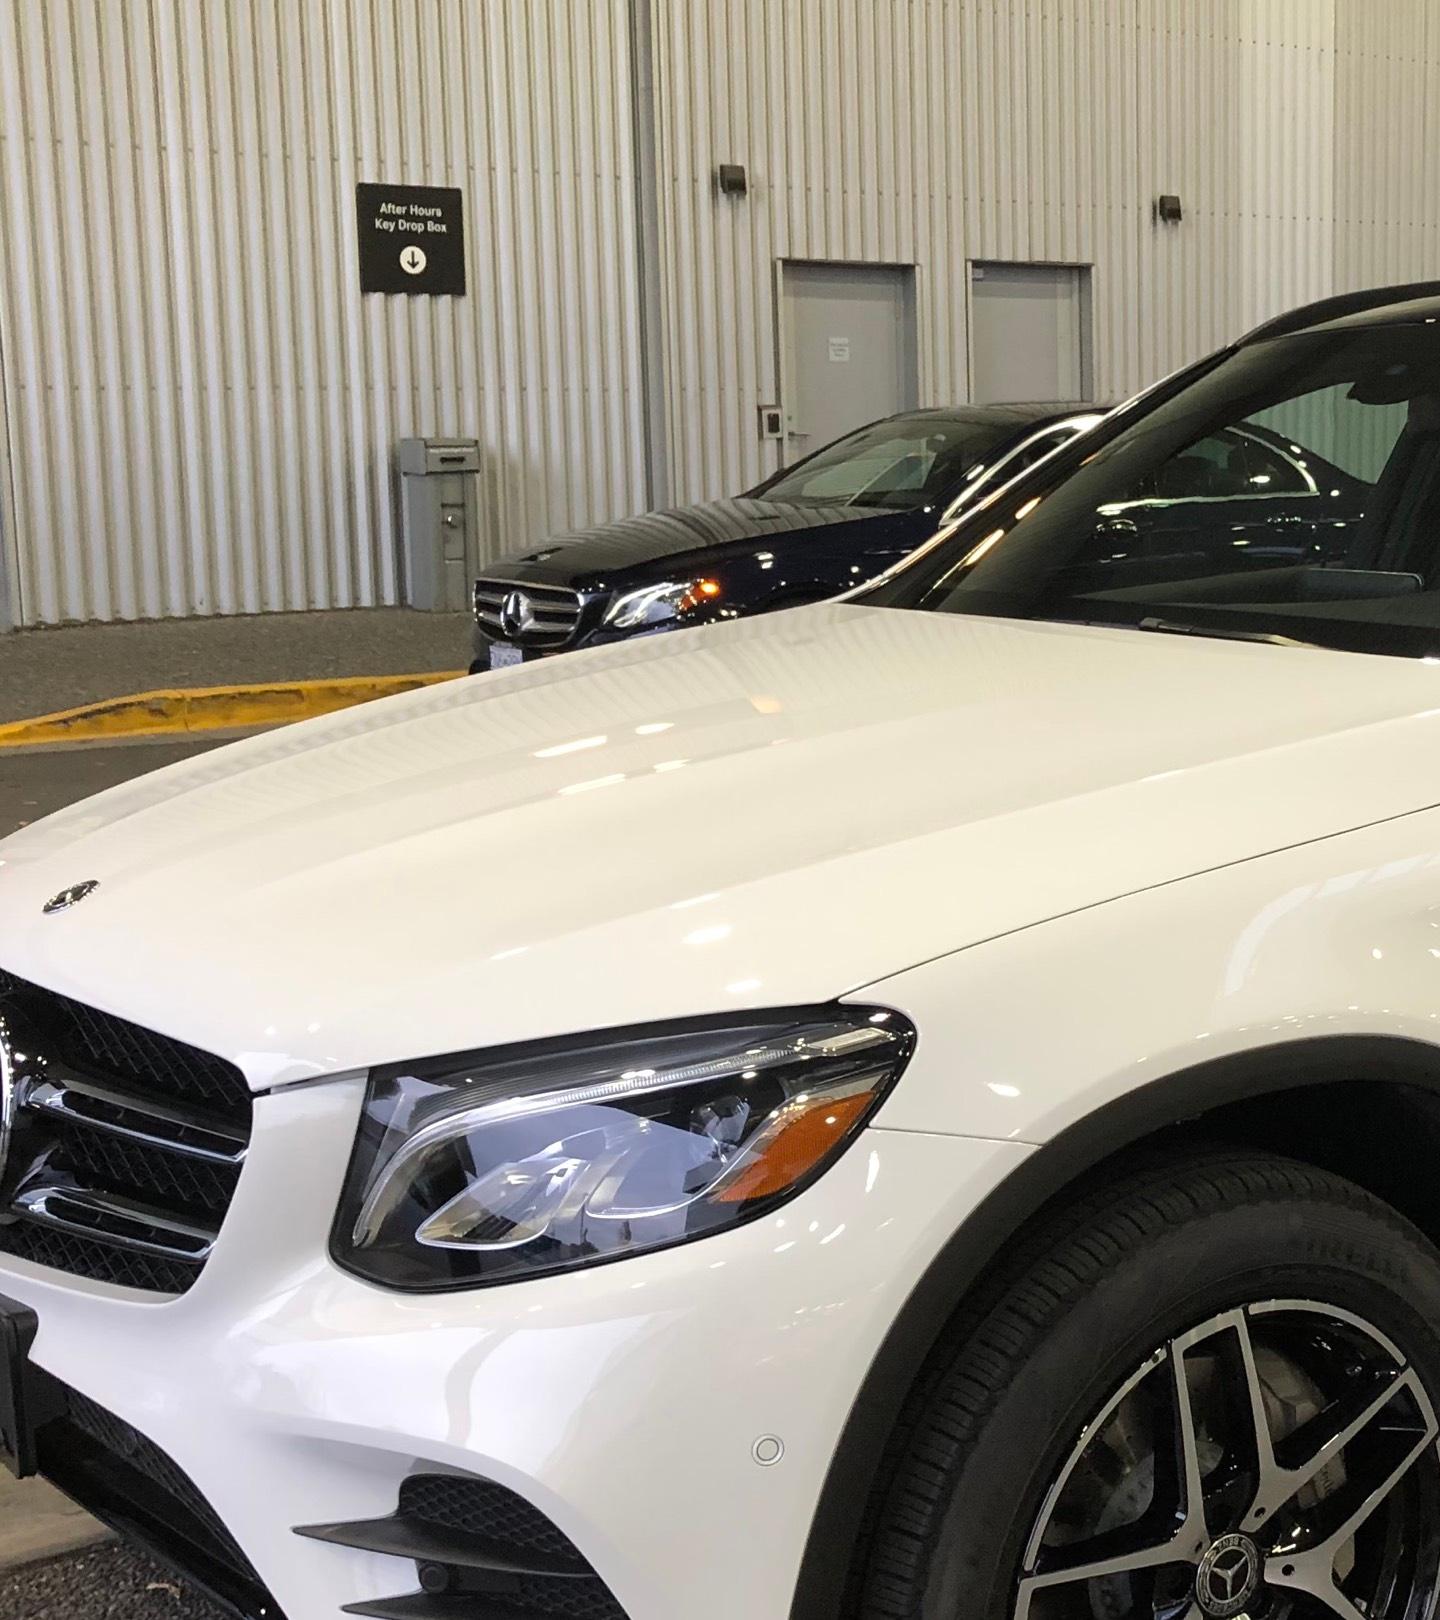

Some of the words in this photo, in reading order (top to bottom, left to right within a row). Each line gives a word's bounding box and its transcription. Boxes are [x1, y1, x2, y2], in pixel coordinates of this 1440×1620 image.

[380, 202, 407, 215] After
[410, 204, 442, 217] Hours
[375, 218, 395, 233] Key
[398, 219, 425, 234] Drop
[427, 220, 447, 233] Box
